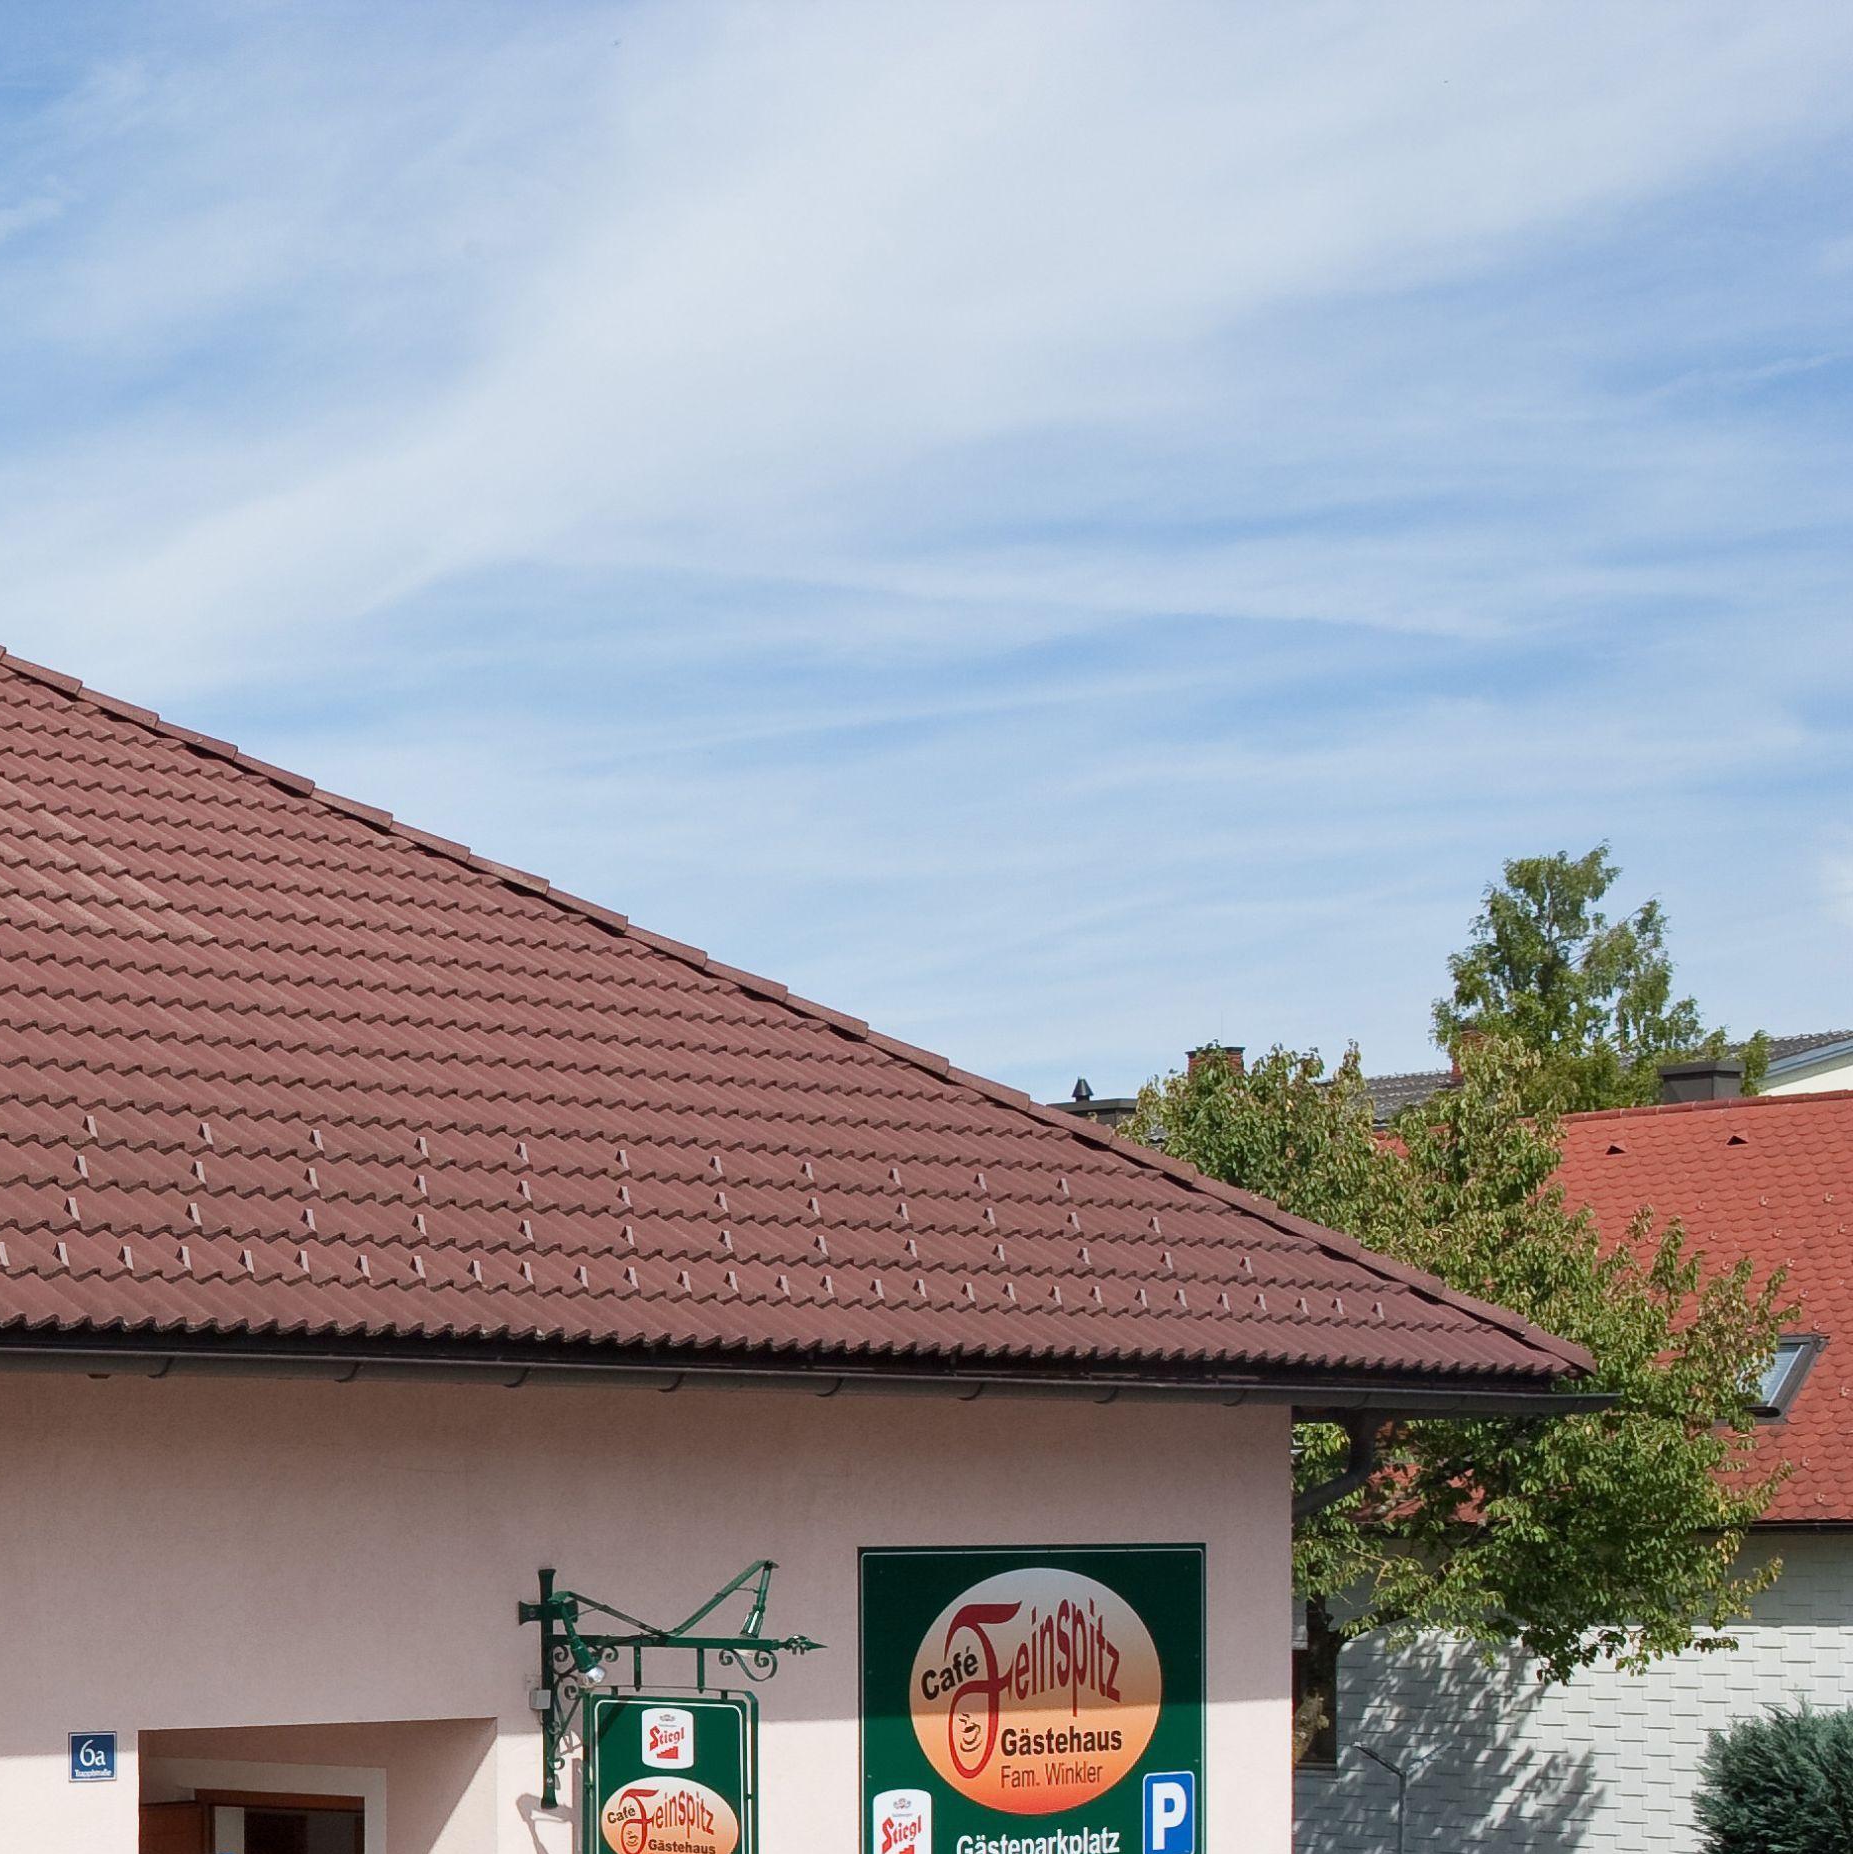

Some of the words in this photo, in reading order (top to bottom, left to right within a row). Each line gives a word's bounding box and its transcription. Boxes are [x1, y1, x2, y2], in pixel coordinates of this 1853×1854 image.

[921, 1646, 979, 1701] Café
[944, 1597, 1121, 1779] Feinspitz
[79, 1739, 107, 1767] 6a
[649, 1725, 685, 1751] Stiegl
[1000, 1725, 1123, 1757] Gästehaus
[1000, 1764, 1041, 1789] Fam.
[1045, 1763, 1103, 1787] Winkler
[607, 1806, 636, 1825] Café
[1152, 1782, 1187, 1851] P
